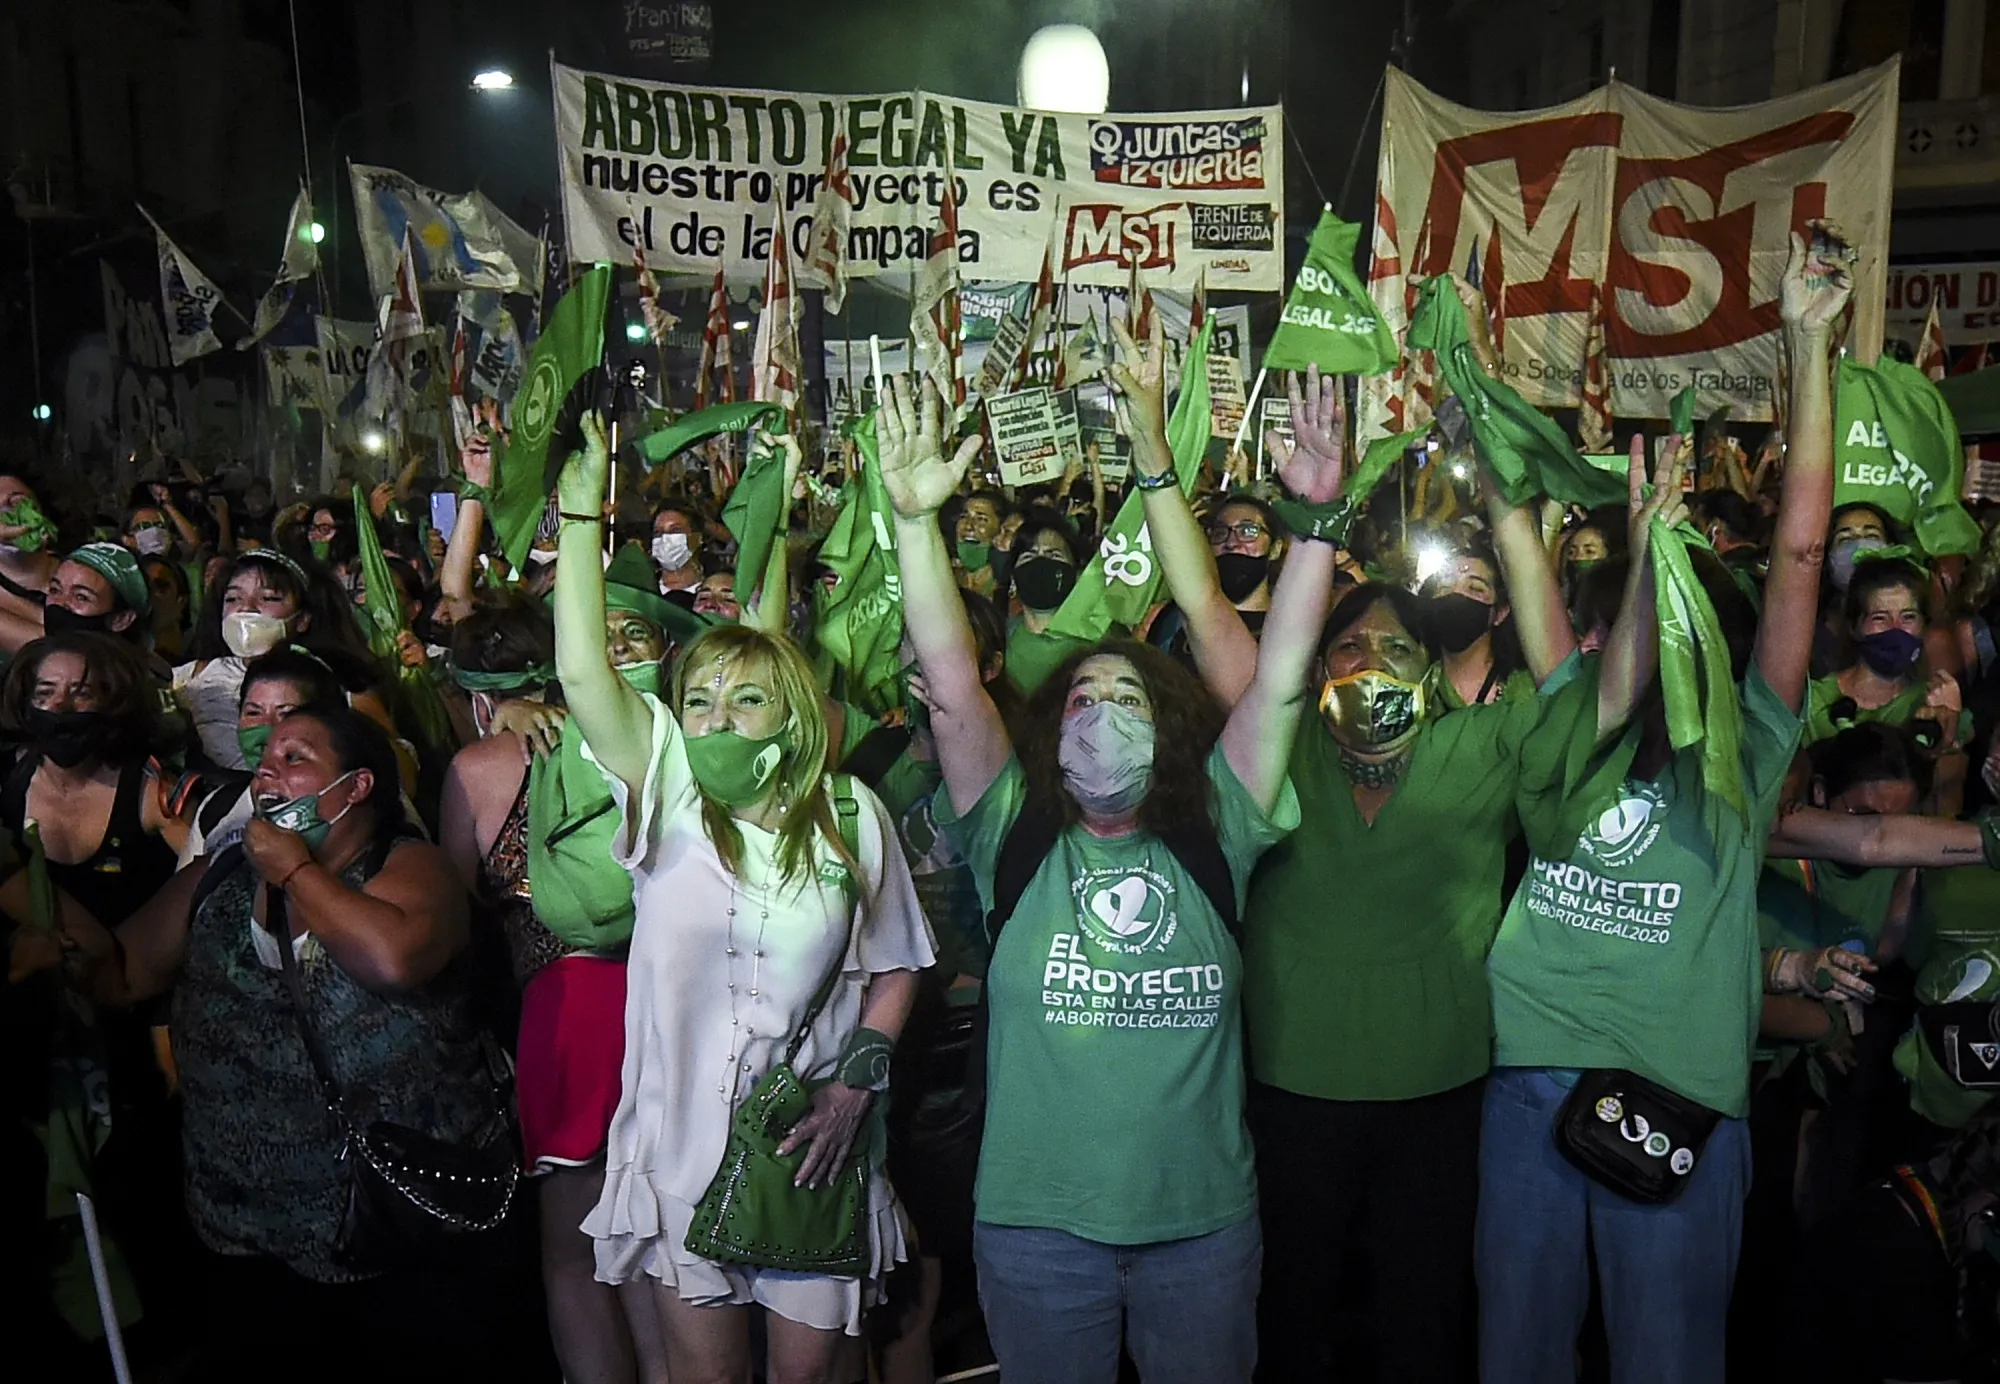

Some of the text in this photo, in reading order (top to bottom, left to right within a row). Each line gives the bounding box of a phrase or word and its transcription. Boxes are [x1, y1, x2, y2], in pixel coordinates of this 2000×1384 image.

[582, 76, 807, 166] ABORTO
[1000, 111, 1067, 181] YA
[583, 153, 1041, 211] nuestro pryecto es
[1194, 204, 1264, 224] FRENTE DE
[617, 206, 981, 269] el de la Cmpaa
[1070, 205, 1188, 263] MST
[1193, 225, 1271, 242] IZQUIERDA
[1449, 140, 1843, 336] MST
[1622, 368, 1648, 390] de
[1652, 367, 1681, 390] los
[1688, 367, 1773, 398] Trabaja
[1843, 462, 1905, 487] LEGA
[1557, 890, 1580, 909] EN
[1583, 898, 1614, 916] LAS
[1616, 905, 1674, 927] CALLES
[1048, 933, 1087, 961] EL
[1043, 961, 1224, 995] PROYECTO
[1042, 990, 1221, 1011] ESTA EN LAS CALLES
[1044, 1010, 1219, 1028] #ABORTOLEGAL2020
